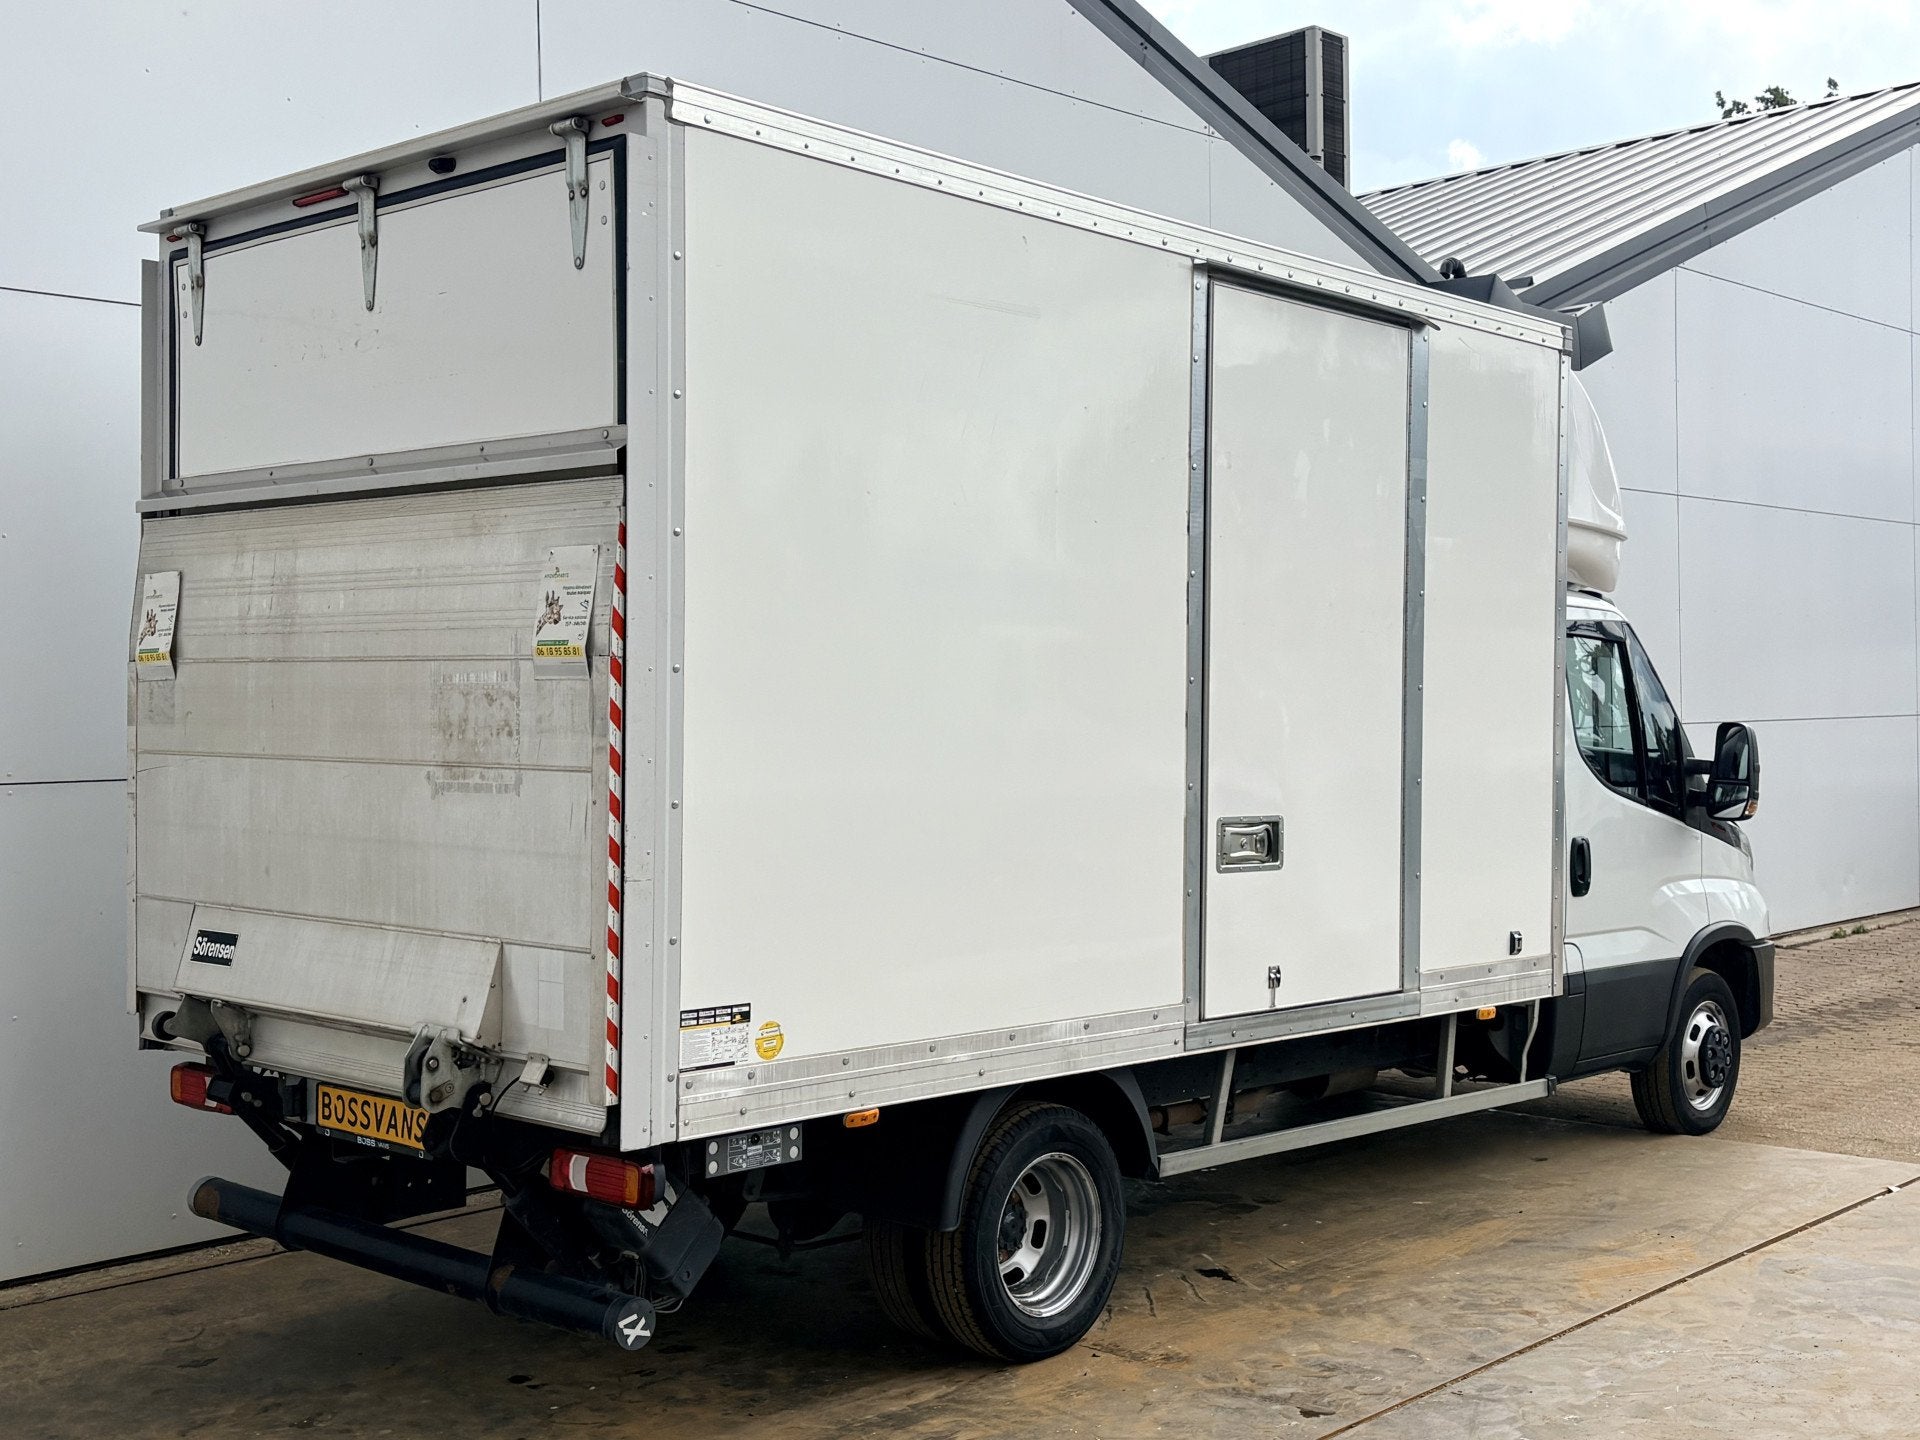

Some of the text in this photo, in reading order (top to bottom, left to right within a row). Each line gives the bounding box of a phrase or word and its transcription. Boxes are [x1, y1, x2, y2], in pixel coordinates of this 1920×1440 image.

[536, 646, 581, 656] 06 18 95 85 81
[193, 936, 235, 960] Sörensen
[322, 1091, 426, 1142] BOSSVANS
[357, 1135, 376, 1147] BOSS
